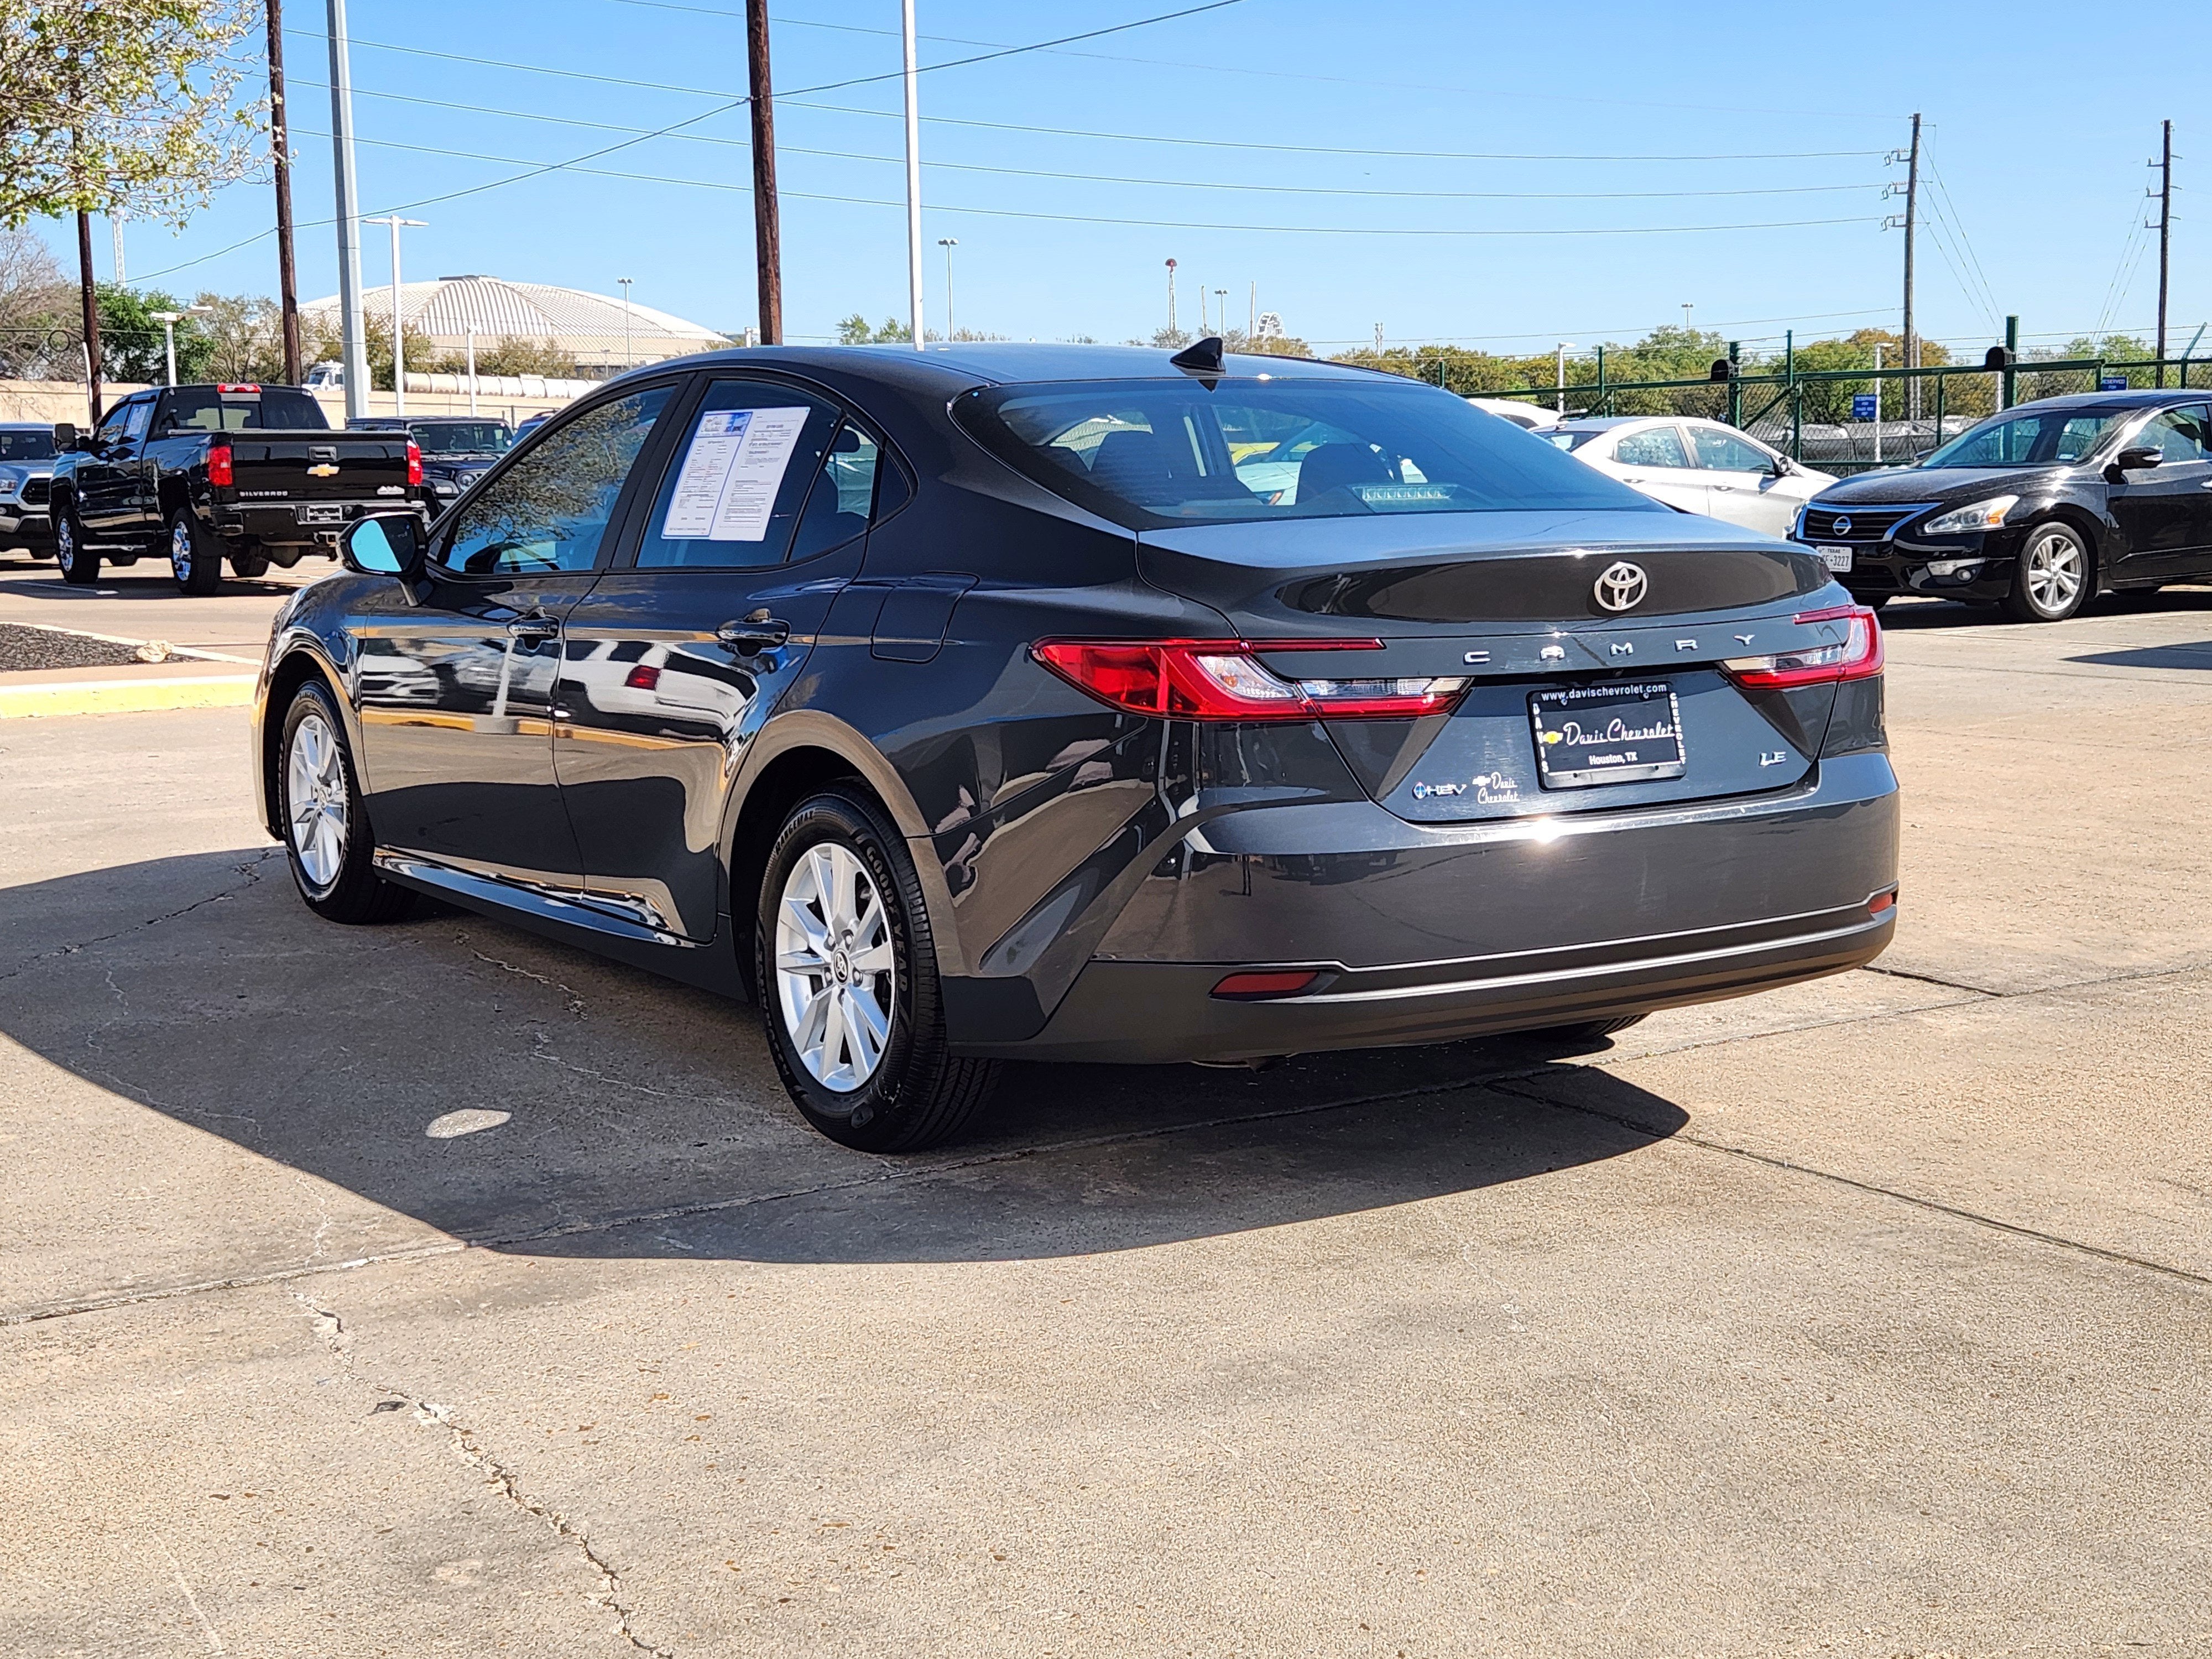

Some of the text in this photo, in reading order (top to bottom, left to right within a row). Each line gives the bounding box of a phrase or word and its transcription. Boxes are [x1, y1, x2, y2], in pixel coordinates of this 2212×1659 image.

[1464, 634, 1756, 664] CAMRY
[1541, 684, 1667, 701] www.davischevrolet.com
[1532, 703, 1549, 773] DAVIS
[1563, 718, 1676, 746] Davis Chevrolet
[1670, 692, 1687, 765] CHEVROLET
[1589, 752, 1639, 765] Houston, TX
[1760, 751, 1787, 766] LE
[1426, 783, 1468, 796] HEV
[1491, 771, 1518, 790] Davis
[1477, 787, 1520, 804] Chevrolet
[866, 846, 908, 992] GOODYEAR
